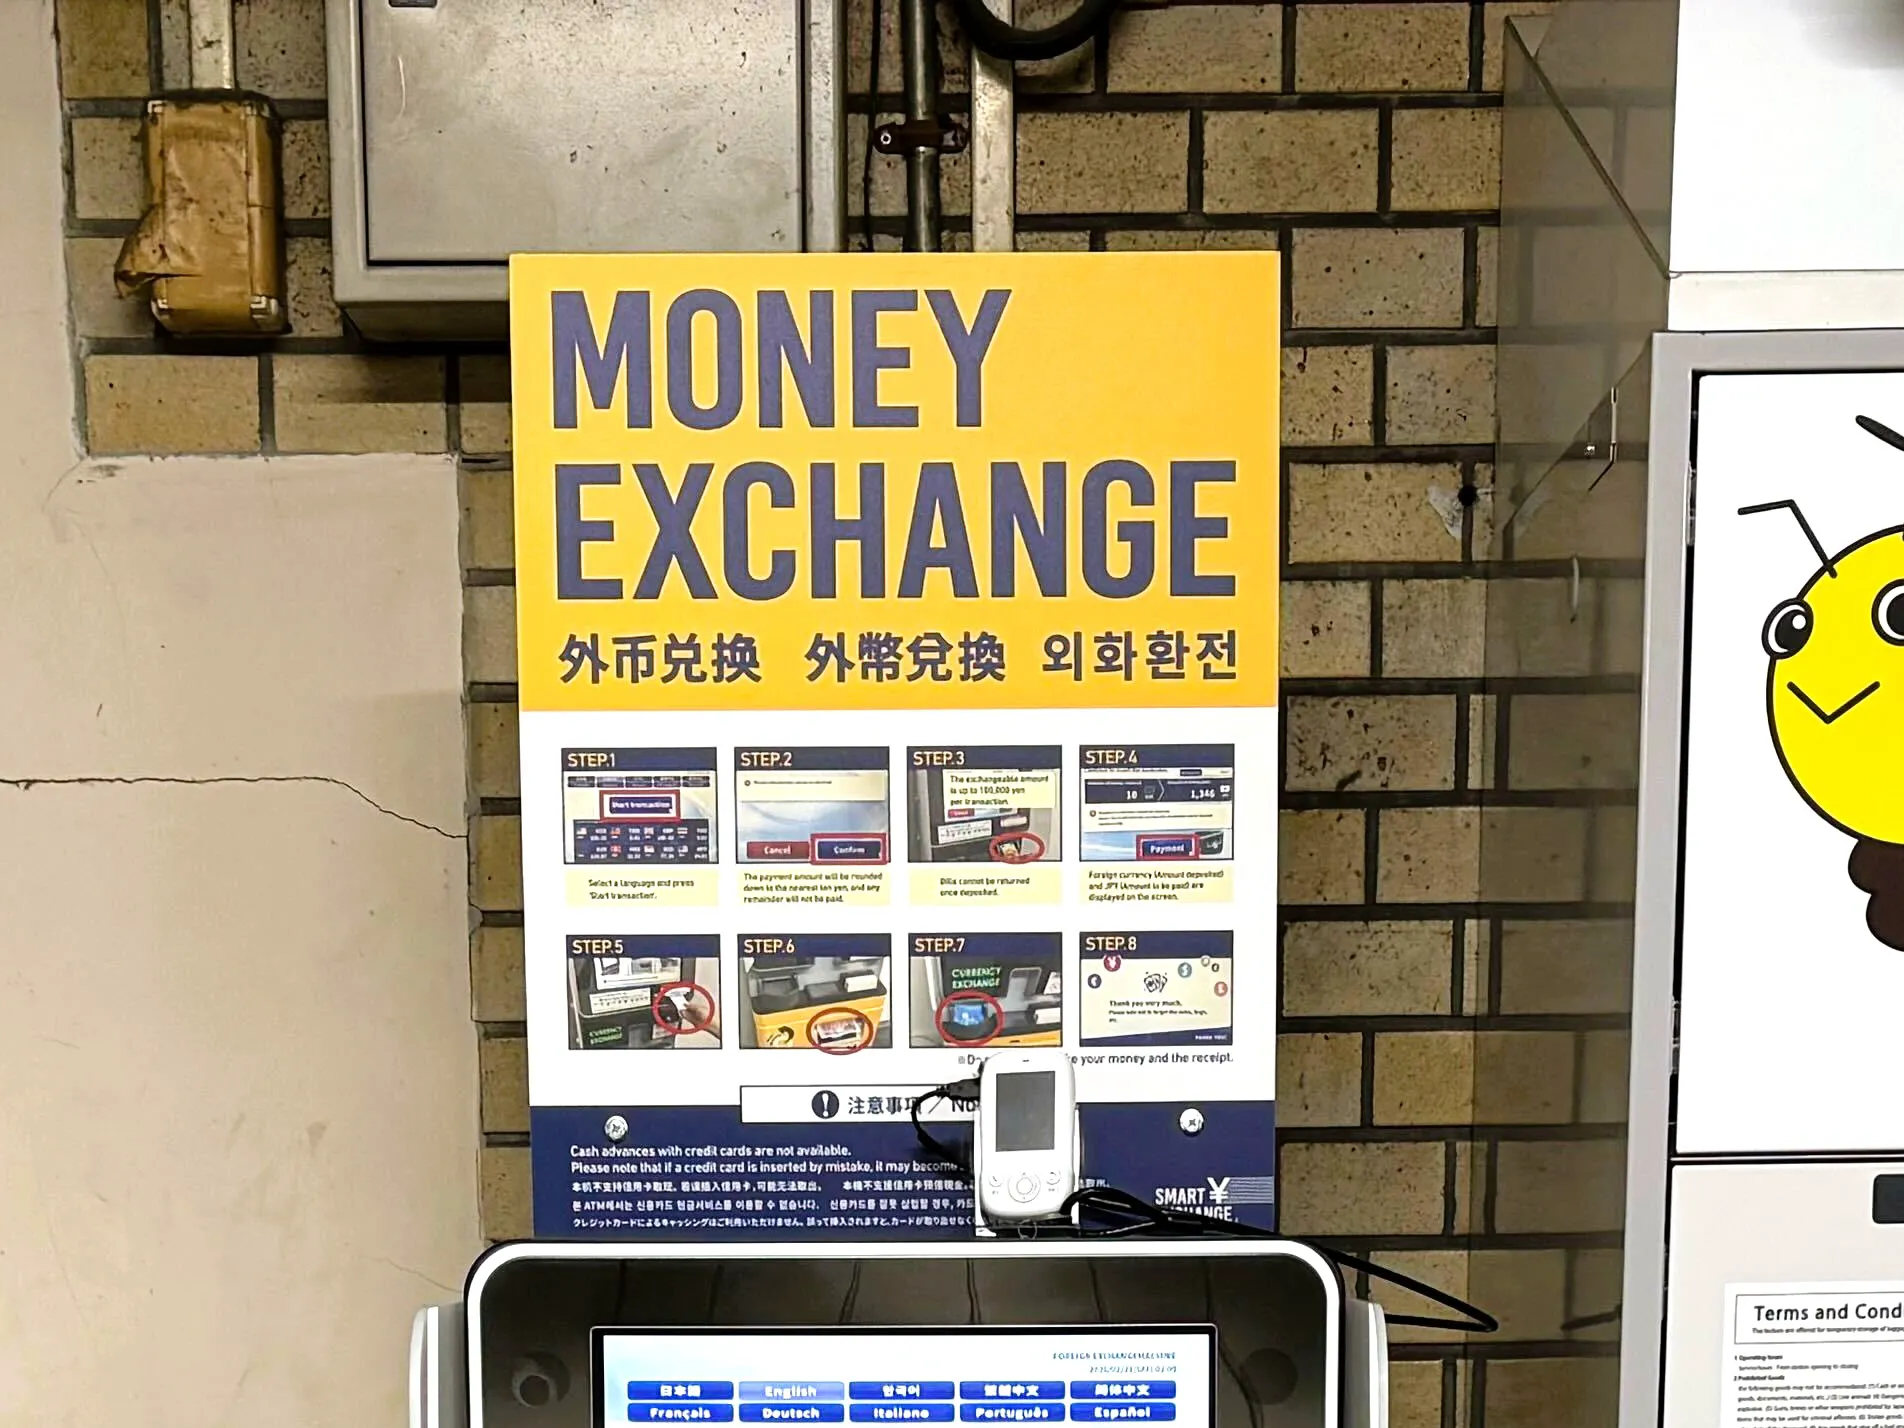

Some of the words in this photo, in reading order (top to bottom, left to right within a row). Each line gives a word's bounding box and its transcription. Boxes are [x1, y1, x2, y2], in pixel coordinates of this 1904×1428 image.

[550, 288, 1013, 431] MONEY
[554, 459, 1237, 601] EXCHANGE
[558, 632, 762, 685] 外币兑换
[803, 630, 1006, 683] 外幣兌換
[1041, 629, 1237, 682] 외화환전
[567, 752, 615, 768] STEP.1
[740, 751, 793, 767] STEP.2
[913, 750, 965, 766] STEP.3
[1085, 749, 1138, 765] STEP.4
[572, 939, 624, 955] STEP.5
[743, 938, 795, 954] STEP.6
[914, 937, 966, 953] STEP.7
[1085, 935, 1137, 951] STEP.8
[1080, 1055, 1106, 1067] your
[1108, 1055, 1146, 1066] money
[1148, 1052, 1169, 1064] and
[1171, 1052, 1189, 1063] the
[1191, 1051, 1234, 1065] receipt.
[570, 1144, 600, 1158] Cash
[601, 1145, 656, 1158] advances
[657, 1145, 683, 1157] with
[684, 1144, 718, 1157] credit
[719, 1145, 753, 1157] cards
[754, 1147, 774, 1157] are
[775, 1145, 795, 1157] not
[796, 1143, 852, 1157] available.
[1753, 1305, 1809, 1322] Terms
[1814, 1303, 1849, 1320] and
[764, 1384, 817, 1400] English
[649, 1406, 711, 1421] Français
[762, 1407, 820, 1419] Deutsch
[873, 1406, 930, 1419] Italiano
[975, 1406, 1049, 1421] Português
[1094, 1406, 1151, 1421] Español
